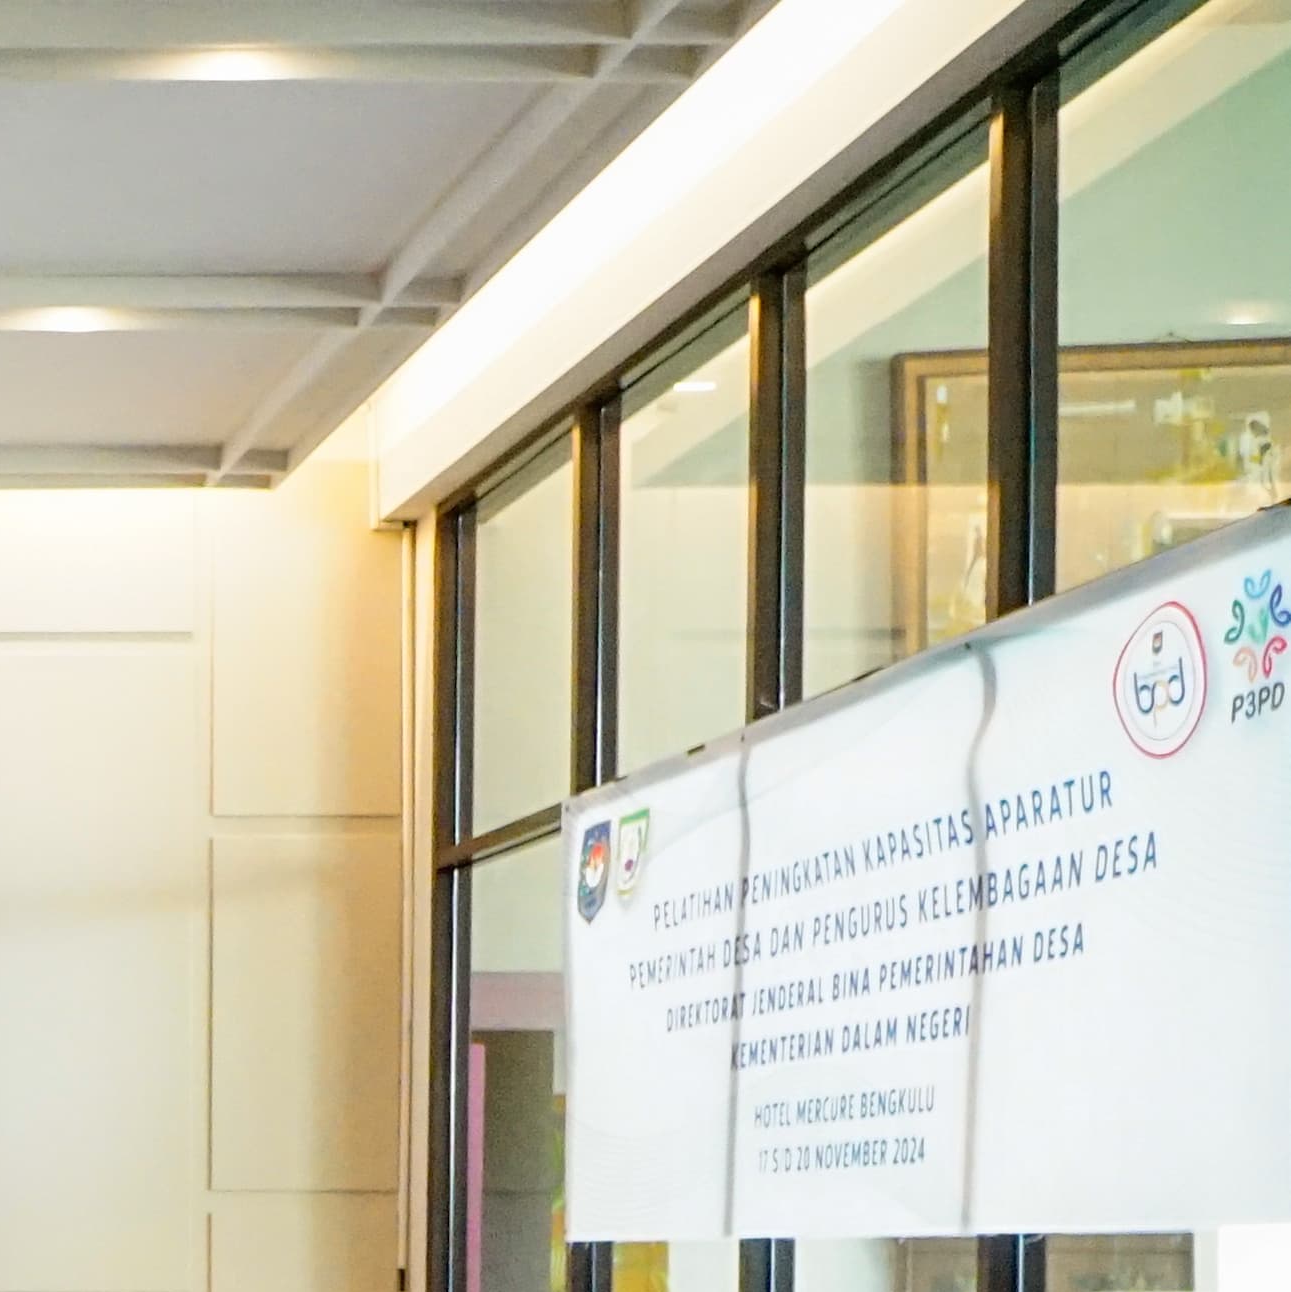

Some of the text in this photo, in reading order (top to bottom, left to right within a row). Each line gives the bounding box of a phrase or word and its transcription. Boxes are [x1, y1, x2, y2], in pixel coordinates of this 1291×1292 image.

[1231, 682, 1286, 724] P3PD
[653, 769, 1113, 932] PELATIHAN PENINGKATAN KAPASITAS APARATUR
[629, 830, 1158, 990] PEMERINTAH DESA DAN PENGURUS KELEMBAGAAN DESA
[666, 922, 1085, 1033] DIREKTORAT JENDERAL BINA PEMERINTAHAN DESA
[730, 1004, 971, 1072] KEMENTERIAN DALAM NEGERI
[754, 1084, 936, 1129] HOTEL MERCURE BENGKULU
[758, 1149, 768, 1175] 17
[796, 1144, 811, 1171] 20
[815, 1138, 887, 1170] NOVEMBER
[892, 1136, 926, 1165] 2024
